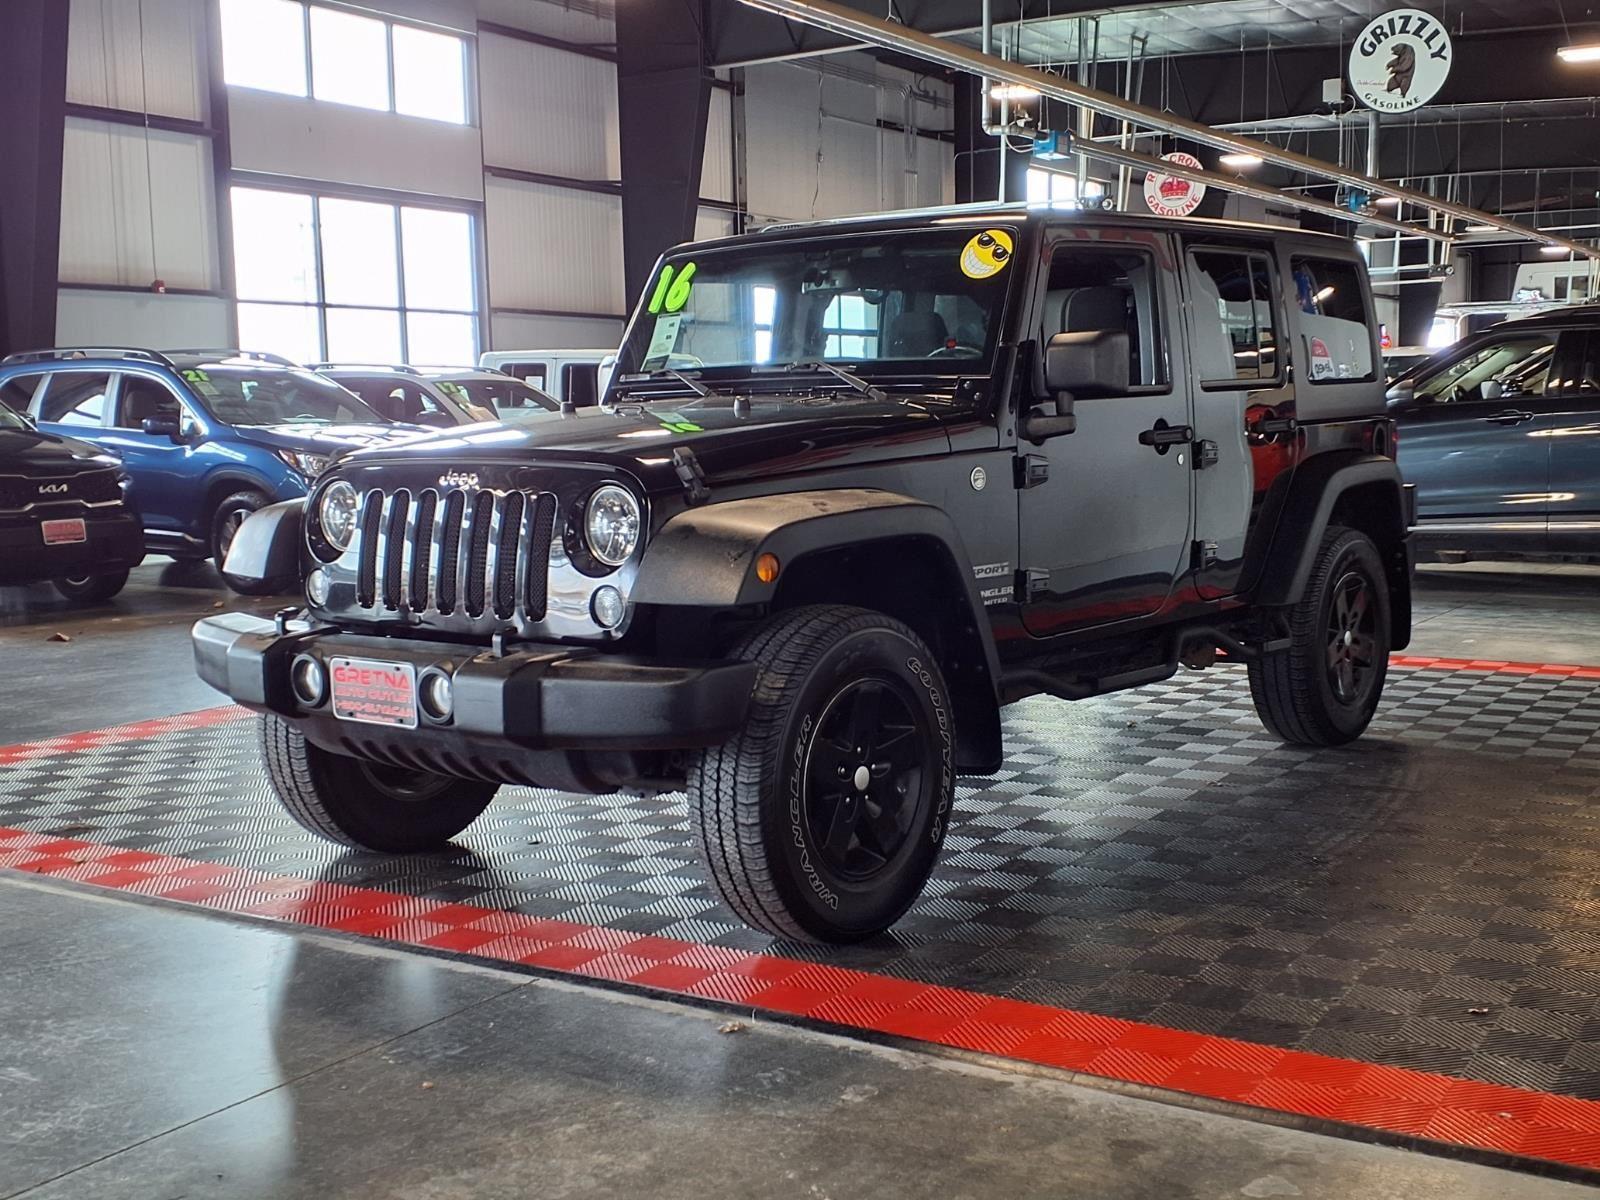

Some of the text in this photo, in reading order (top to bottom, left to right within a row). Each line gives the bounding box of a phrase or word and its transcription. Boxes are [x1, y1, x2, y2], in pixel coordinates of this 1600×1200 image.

[1360, 15, 1447, 61] GRIZZLY
[1364, 92, 1421, 110] GASOLINE
[1147, 193, 1200, 217] GASOLINE
[648, 262, 696, 313] 16
[181, 369, 210, 381] 21
[38, 483, 68, 494] KIA
[438, 467, 480, 490] Jeep
[974, 563, 1008, 577] PORT
[334, 667, 411, 690] GRETNA
[906, 656, 952, 844] GOODYEAR
[789, 713, 840, 910] WRANGLER
